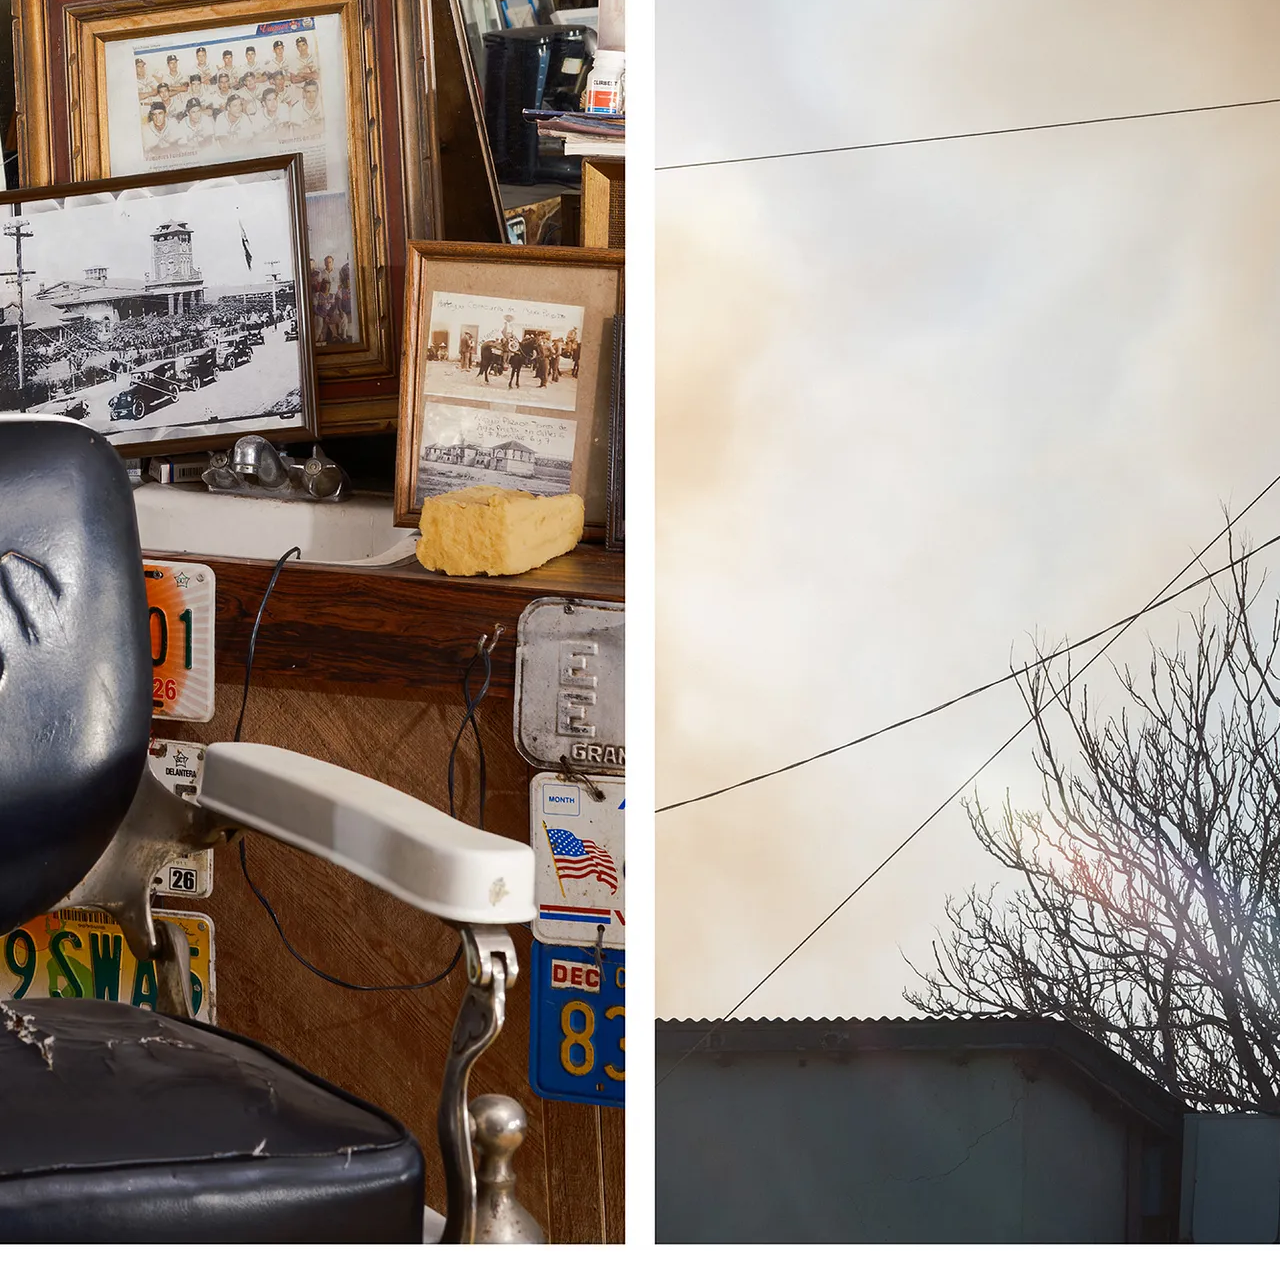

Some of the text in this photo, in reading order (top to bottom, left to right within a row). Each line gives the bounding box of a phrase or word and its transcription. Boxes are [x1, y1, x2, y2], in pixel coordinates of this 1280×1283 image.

[152, 678, 177, 700] 26
[165, 767, 197, 778] DELANTERA
[548, 795, 575, 804] MONTH
[172, 870, 195, 891] 26
[553, 963, 601, 989] DEC
